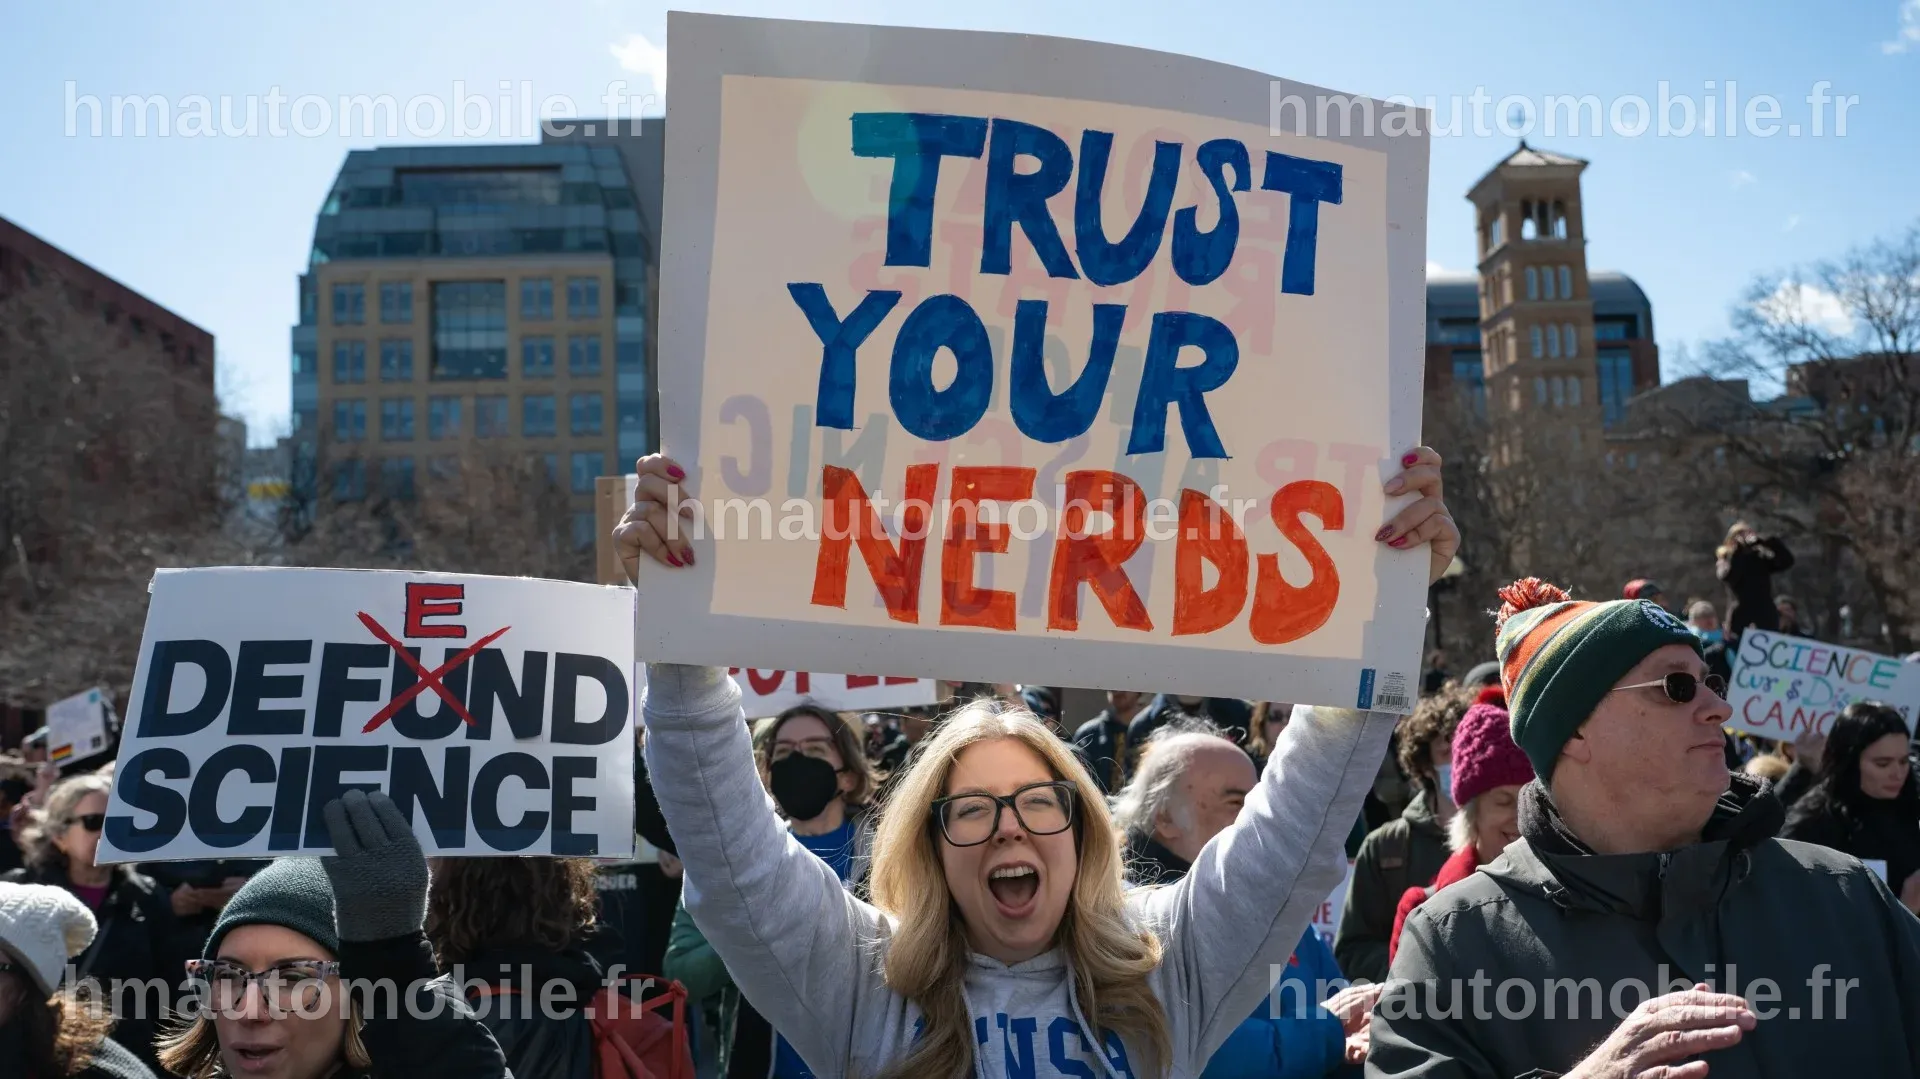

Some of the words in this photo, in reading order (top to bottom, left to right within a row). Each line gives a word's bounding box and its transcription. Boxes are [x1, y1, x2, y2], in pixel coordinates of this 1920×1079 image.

[850, 111, 1344, 297] TRUST
[787, 282, 1239, 461] YOUR
[810, 462, 1345, 645] NERDS
[403, 581, 468, 639] E
[1741, 632, 1901, 690] SCIENCE
[136, 639, 630, 745] DEFUND
[103, 744, 599, 856] SCIENCE
